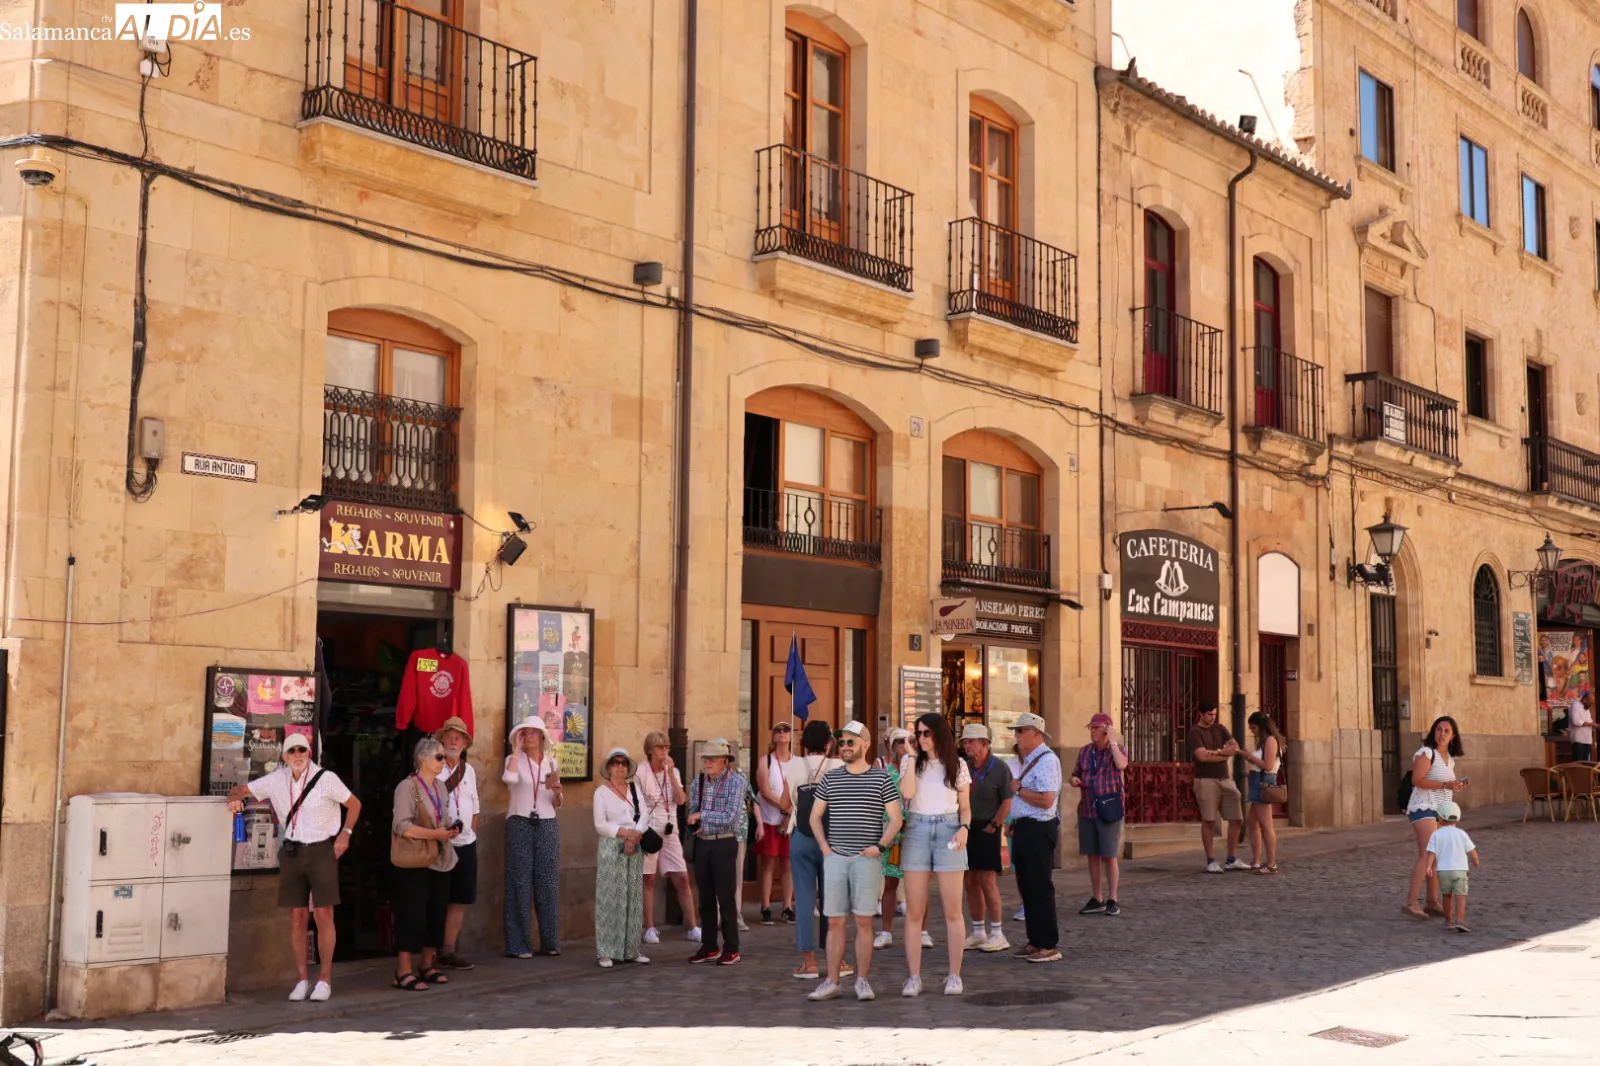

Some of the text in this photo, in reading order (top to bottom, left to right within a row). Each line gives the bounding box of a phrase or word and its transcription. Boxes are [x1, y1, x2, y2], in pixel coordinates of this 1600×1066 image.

[211, 461, 246, 476] ANTIGUA
[337, 504, 382, 519] REGALOS
[394, 511, 444, 528] SOUVENIR
[327, 522, 450, 564] KARMA
[1126, 536, 1214, 572] CAFETERIA
[333, 562, 380, 577] REGALOS
[392, 568, 442, 583] SOUVENIR
[975, 600, 1046, 619] ANSELMO PEREZ
[1127, 588, 1214, 622] Las Campanas
[976, 620, 1033, 635] BORACION PROPIA
[912, 635, 920, 650] 5
